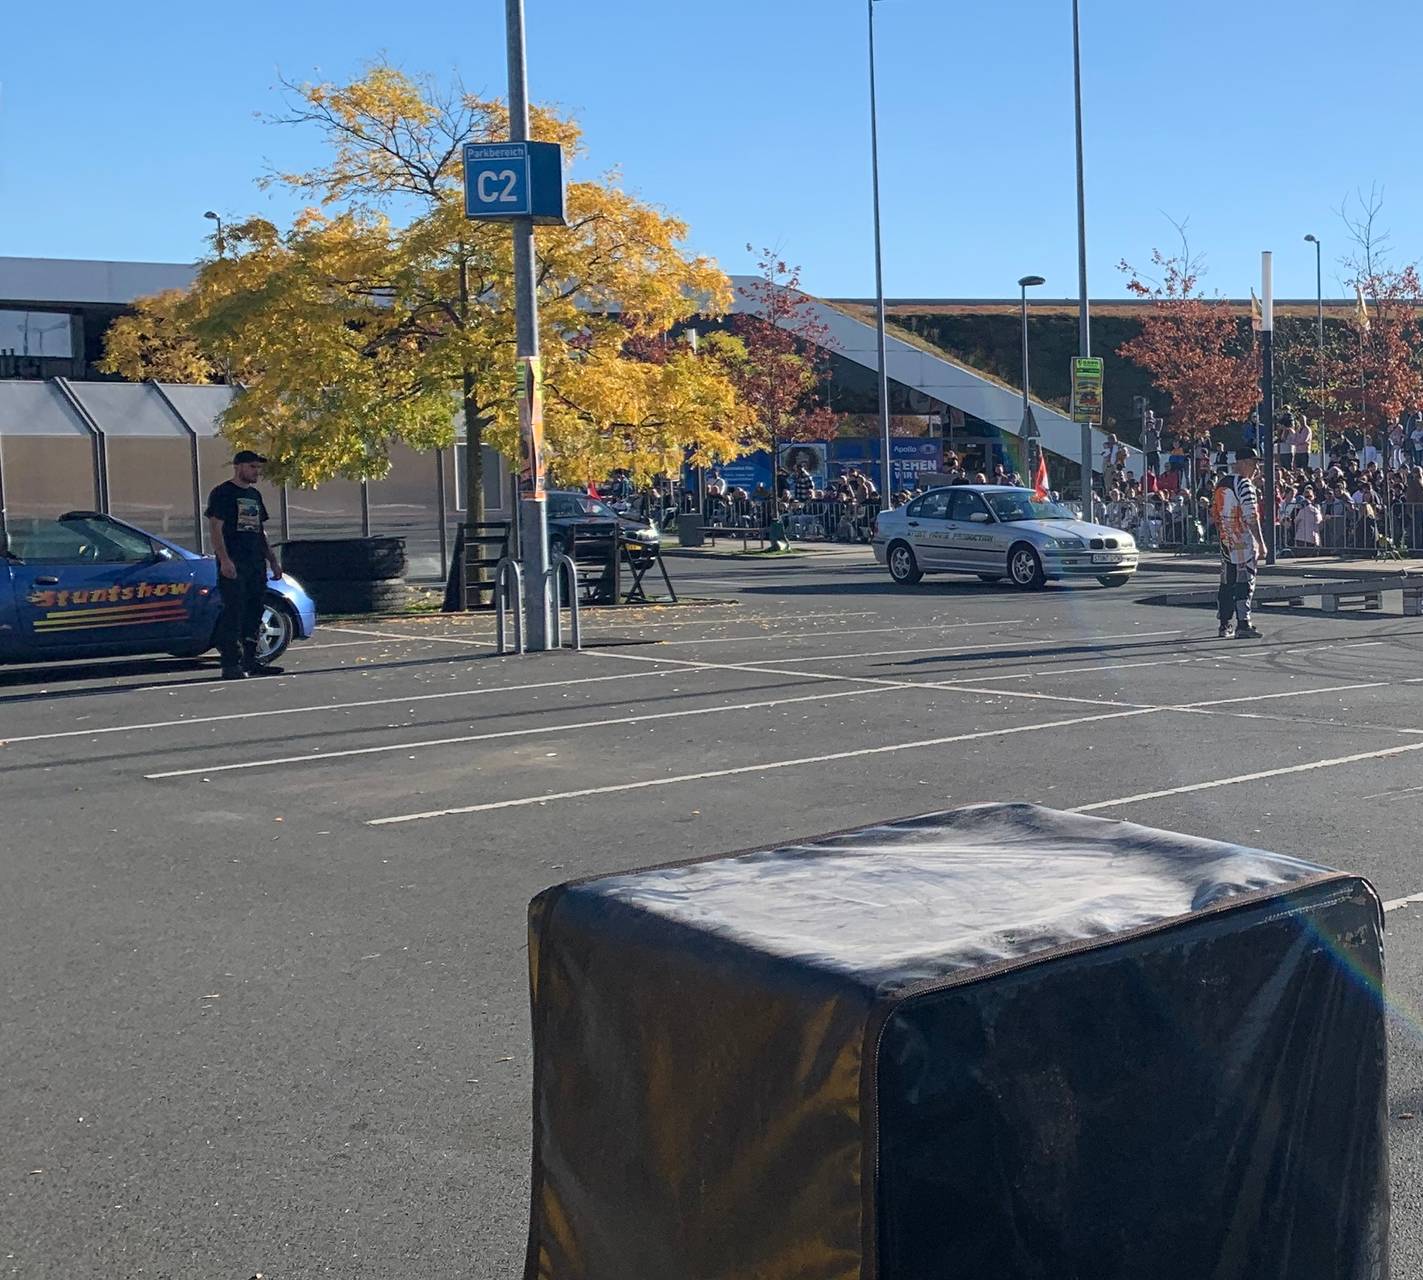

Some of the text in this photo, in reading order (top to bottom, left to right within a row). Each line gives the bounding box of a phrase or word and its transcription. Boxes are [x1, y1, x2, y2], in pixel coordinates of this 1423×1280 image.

[467, 147, 524, 158] Parkbereich
[477, 169, 518, 203] C2
[894, 445, 917, 454] Apollo
[26, 582, 192, 607] Stuntshow
